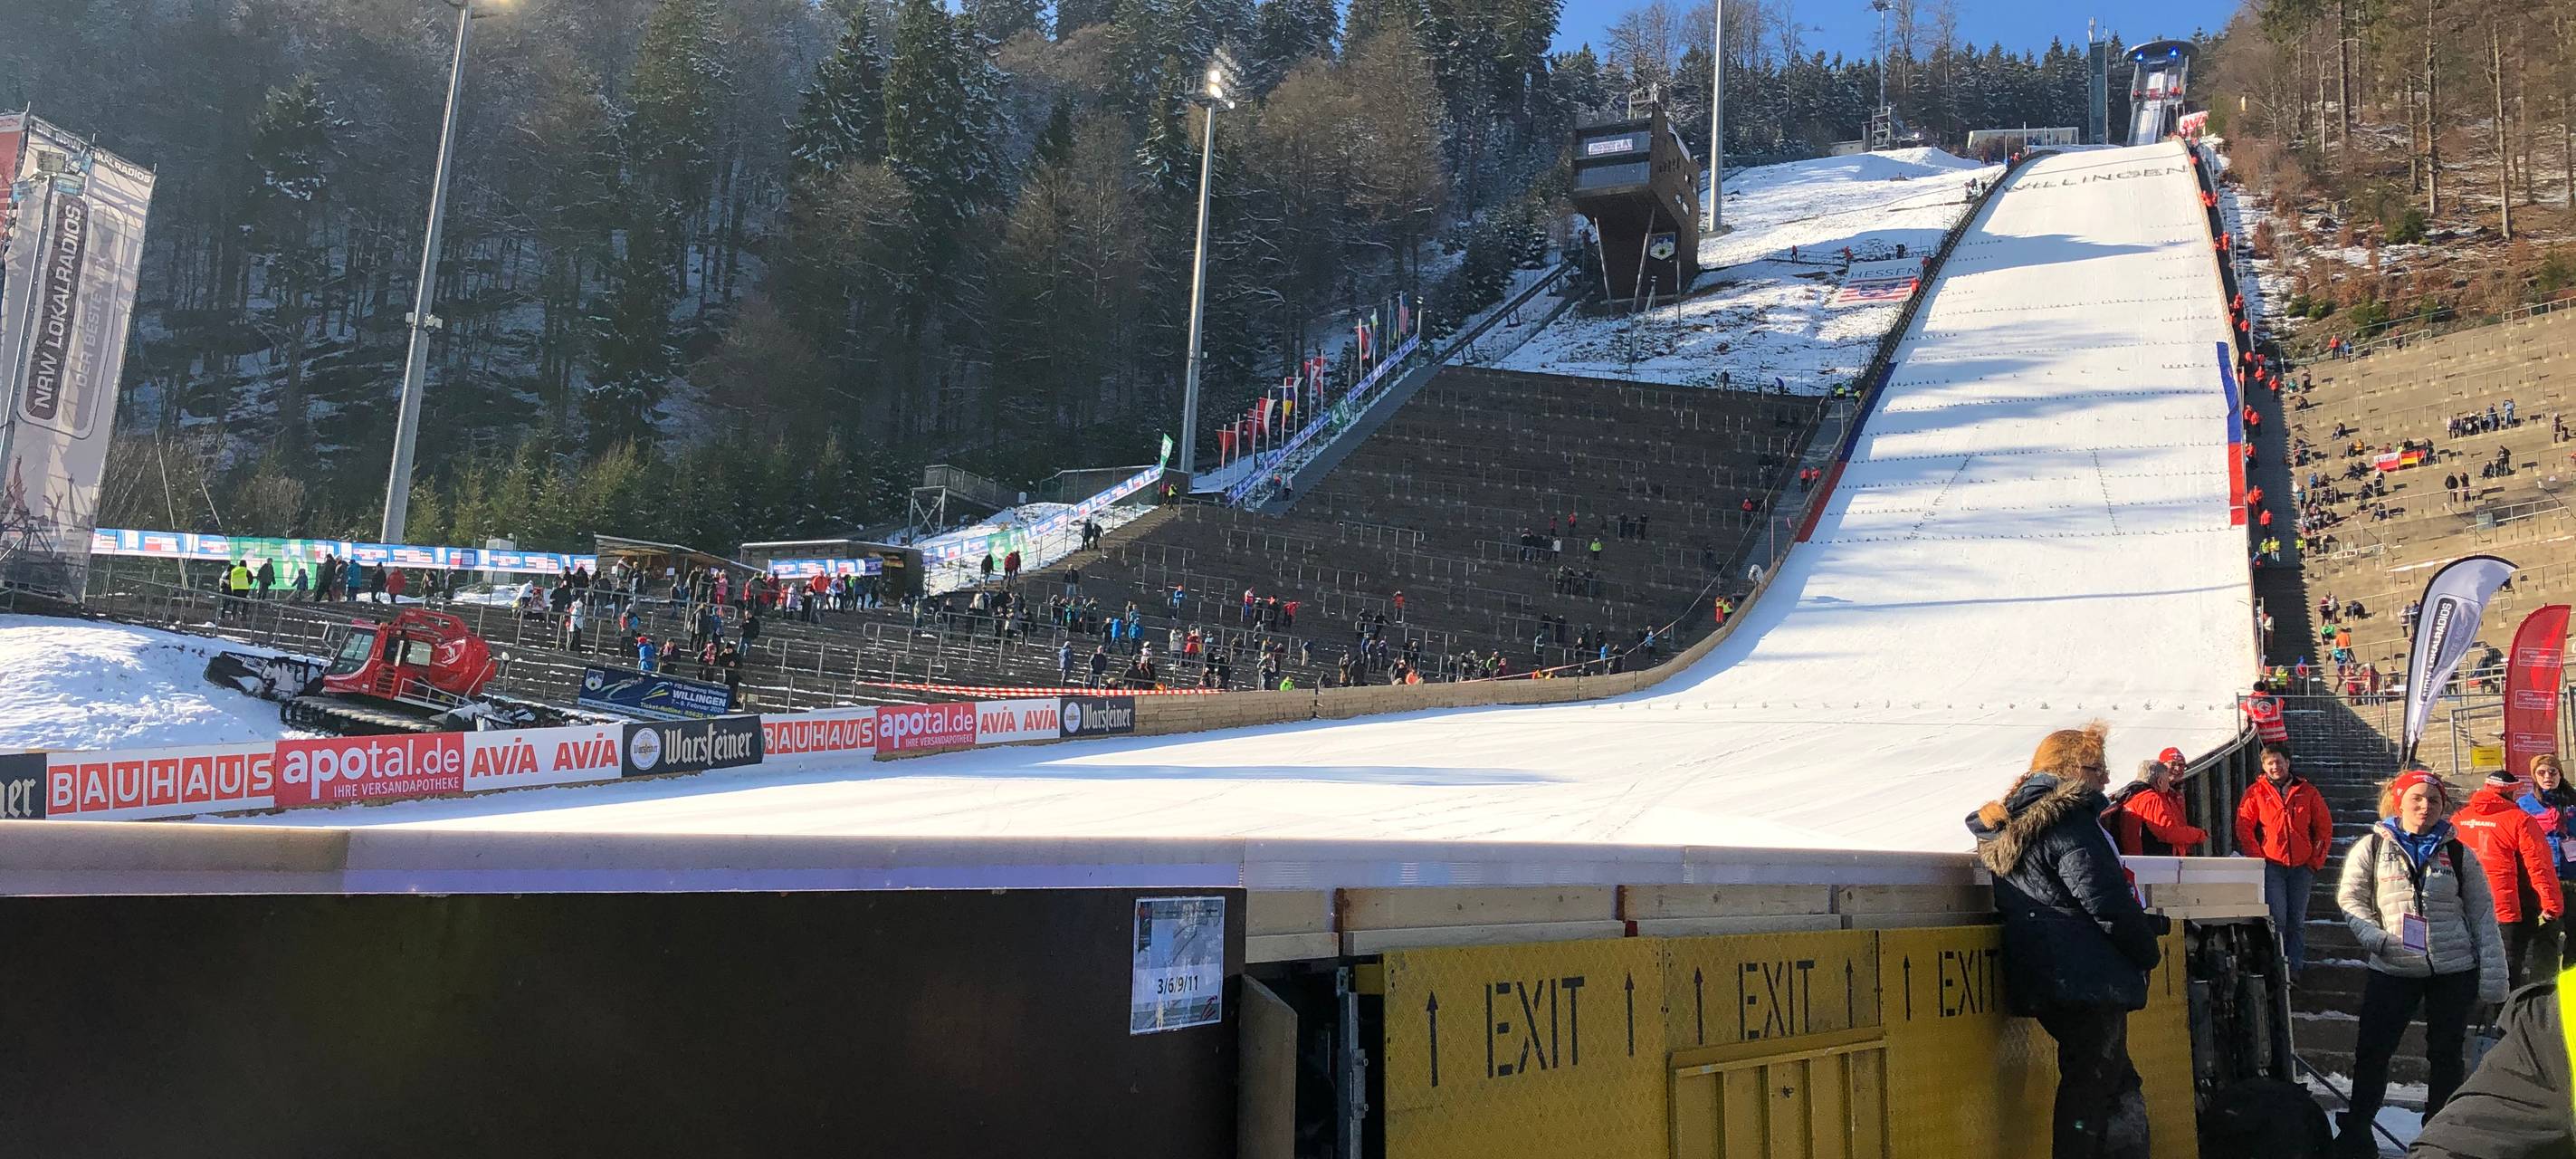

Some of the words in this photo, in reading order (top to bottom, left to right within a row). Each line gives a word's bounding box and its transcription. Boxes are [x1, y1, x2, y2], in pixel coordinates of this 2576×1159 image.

[91, 148, 152, 184] OKALRADIOS
[1850, 266, 1921, 279] HESSEN
[34, 351, 54, 409] NRW
[47, 205, 81, 350] LOKALRADIOS
[75, 350, 93, 388] DER
[85, 292, 103, 347] BESTE
[673, 689, 727, 706] WILLINGEN
[1083, 700, 1131, 733] Warsteiner
[664, 723, 753, 767] Warsteiner
[763, 721, 873, 750] BAUHAUS
[880, 704, 974, 749] apotal.de
[906, 737, 919, 747] IHRE
[920, 733, 973, 747] VERSANDAPOTHEKE
[52, 759, 273, 808] BAUHAUS
[281, 737, 461, 800] apotal.de
[333, 783, 358, 799] IHRE
[361, 776, 460, 796] VERSANDAPOTHEKE
[1157, 974, 1199, 995] 3/6/9/11
[1738, 959, 1815, 1040] EXIT
[1938, 948, 1999, 1018] EXIT
[1485, 975, 1585, 1079] EXIT
